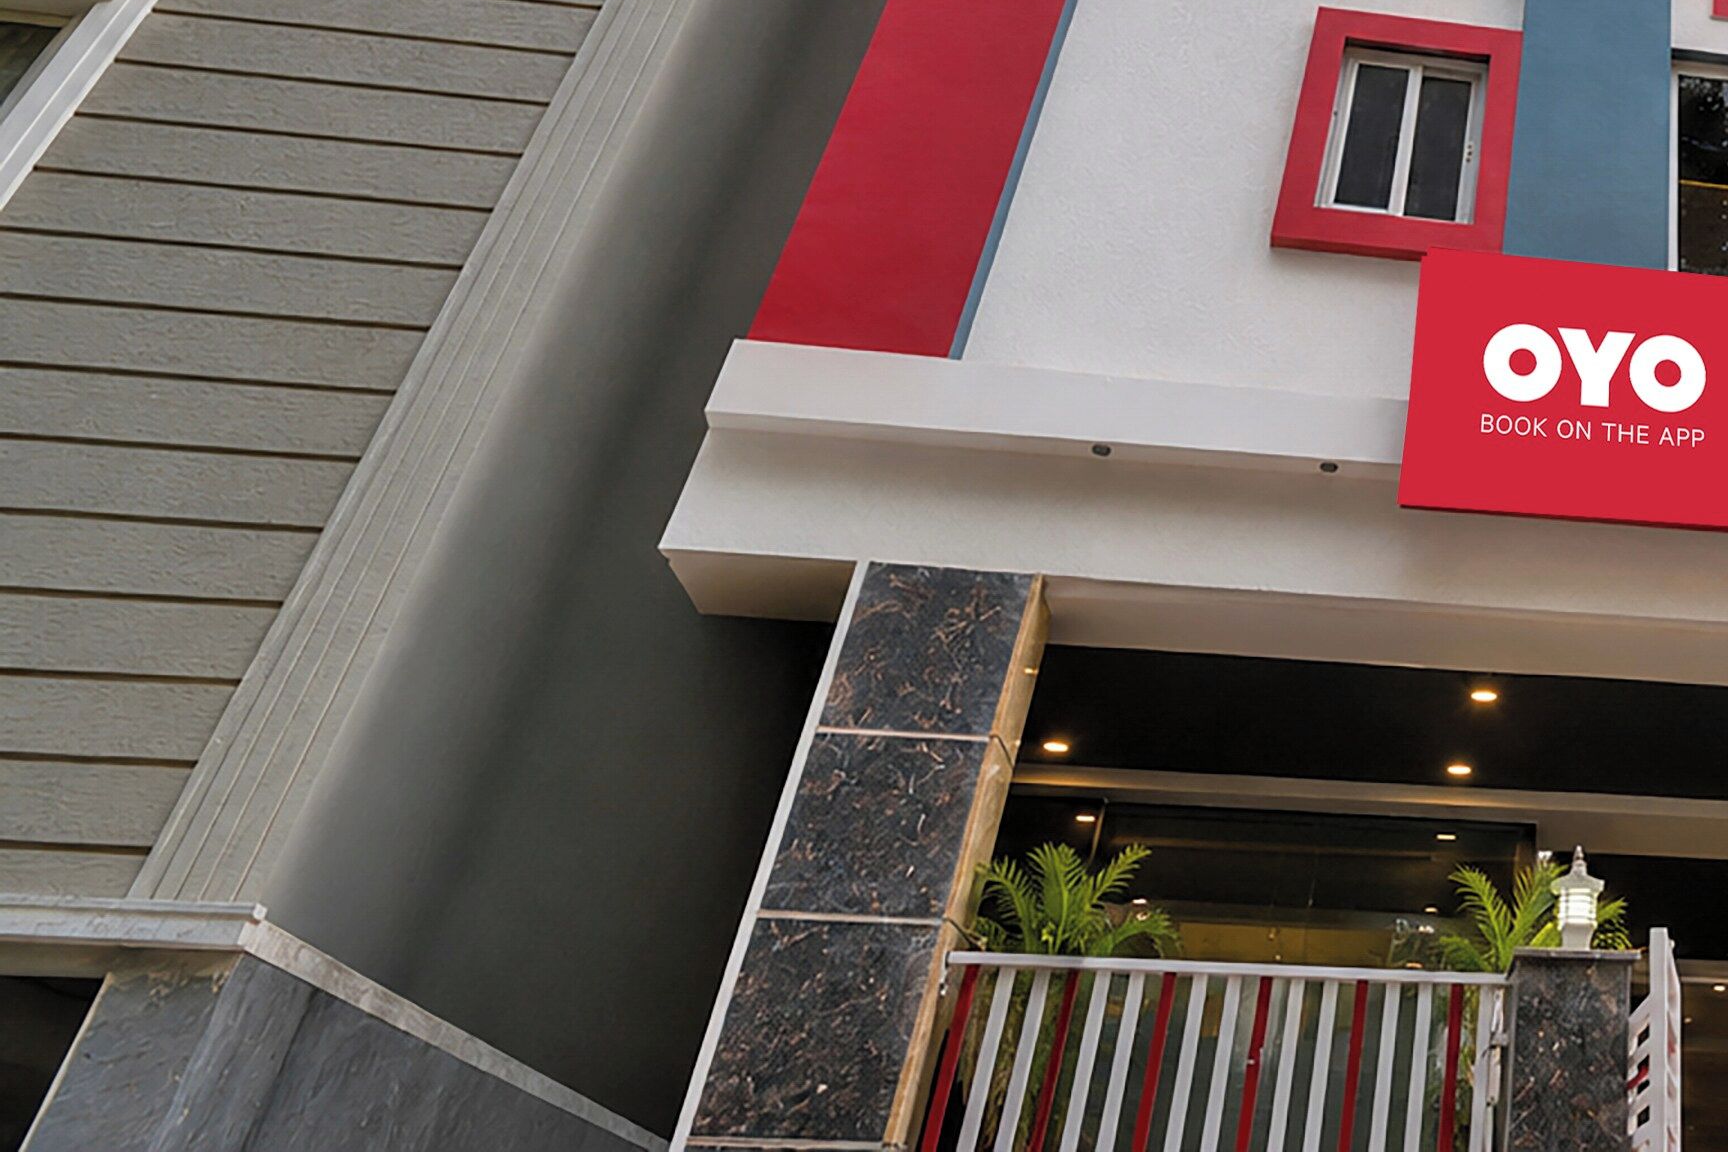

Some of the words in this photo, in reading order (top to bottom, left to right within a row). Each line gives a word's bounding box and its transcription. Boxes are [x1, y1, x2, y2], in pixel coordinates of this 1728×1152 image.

[1483, 323, 1707, 413] OYO
[1480, 413, 1548, 438] BOOK
[1556, 419, 1592, 441] ON
[1601, 422, 1650, 445] THE
[1659, 426, 1706, 448] APP
